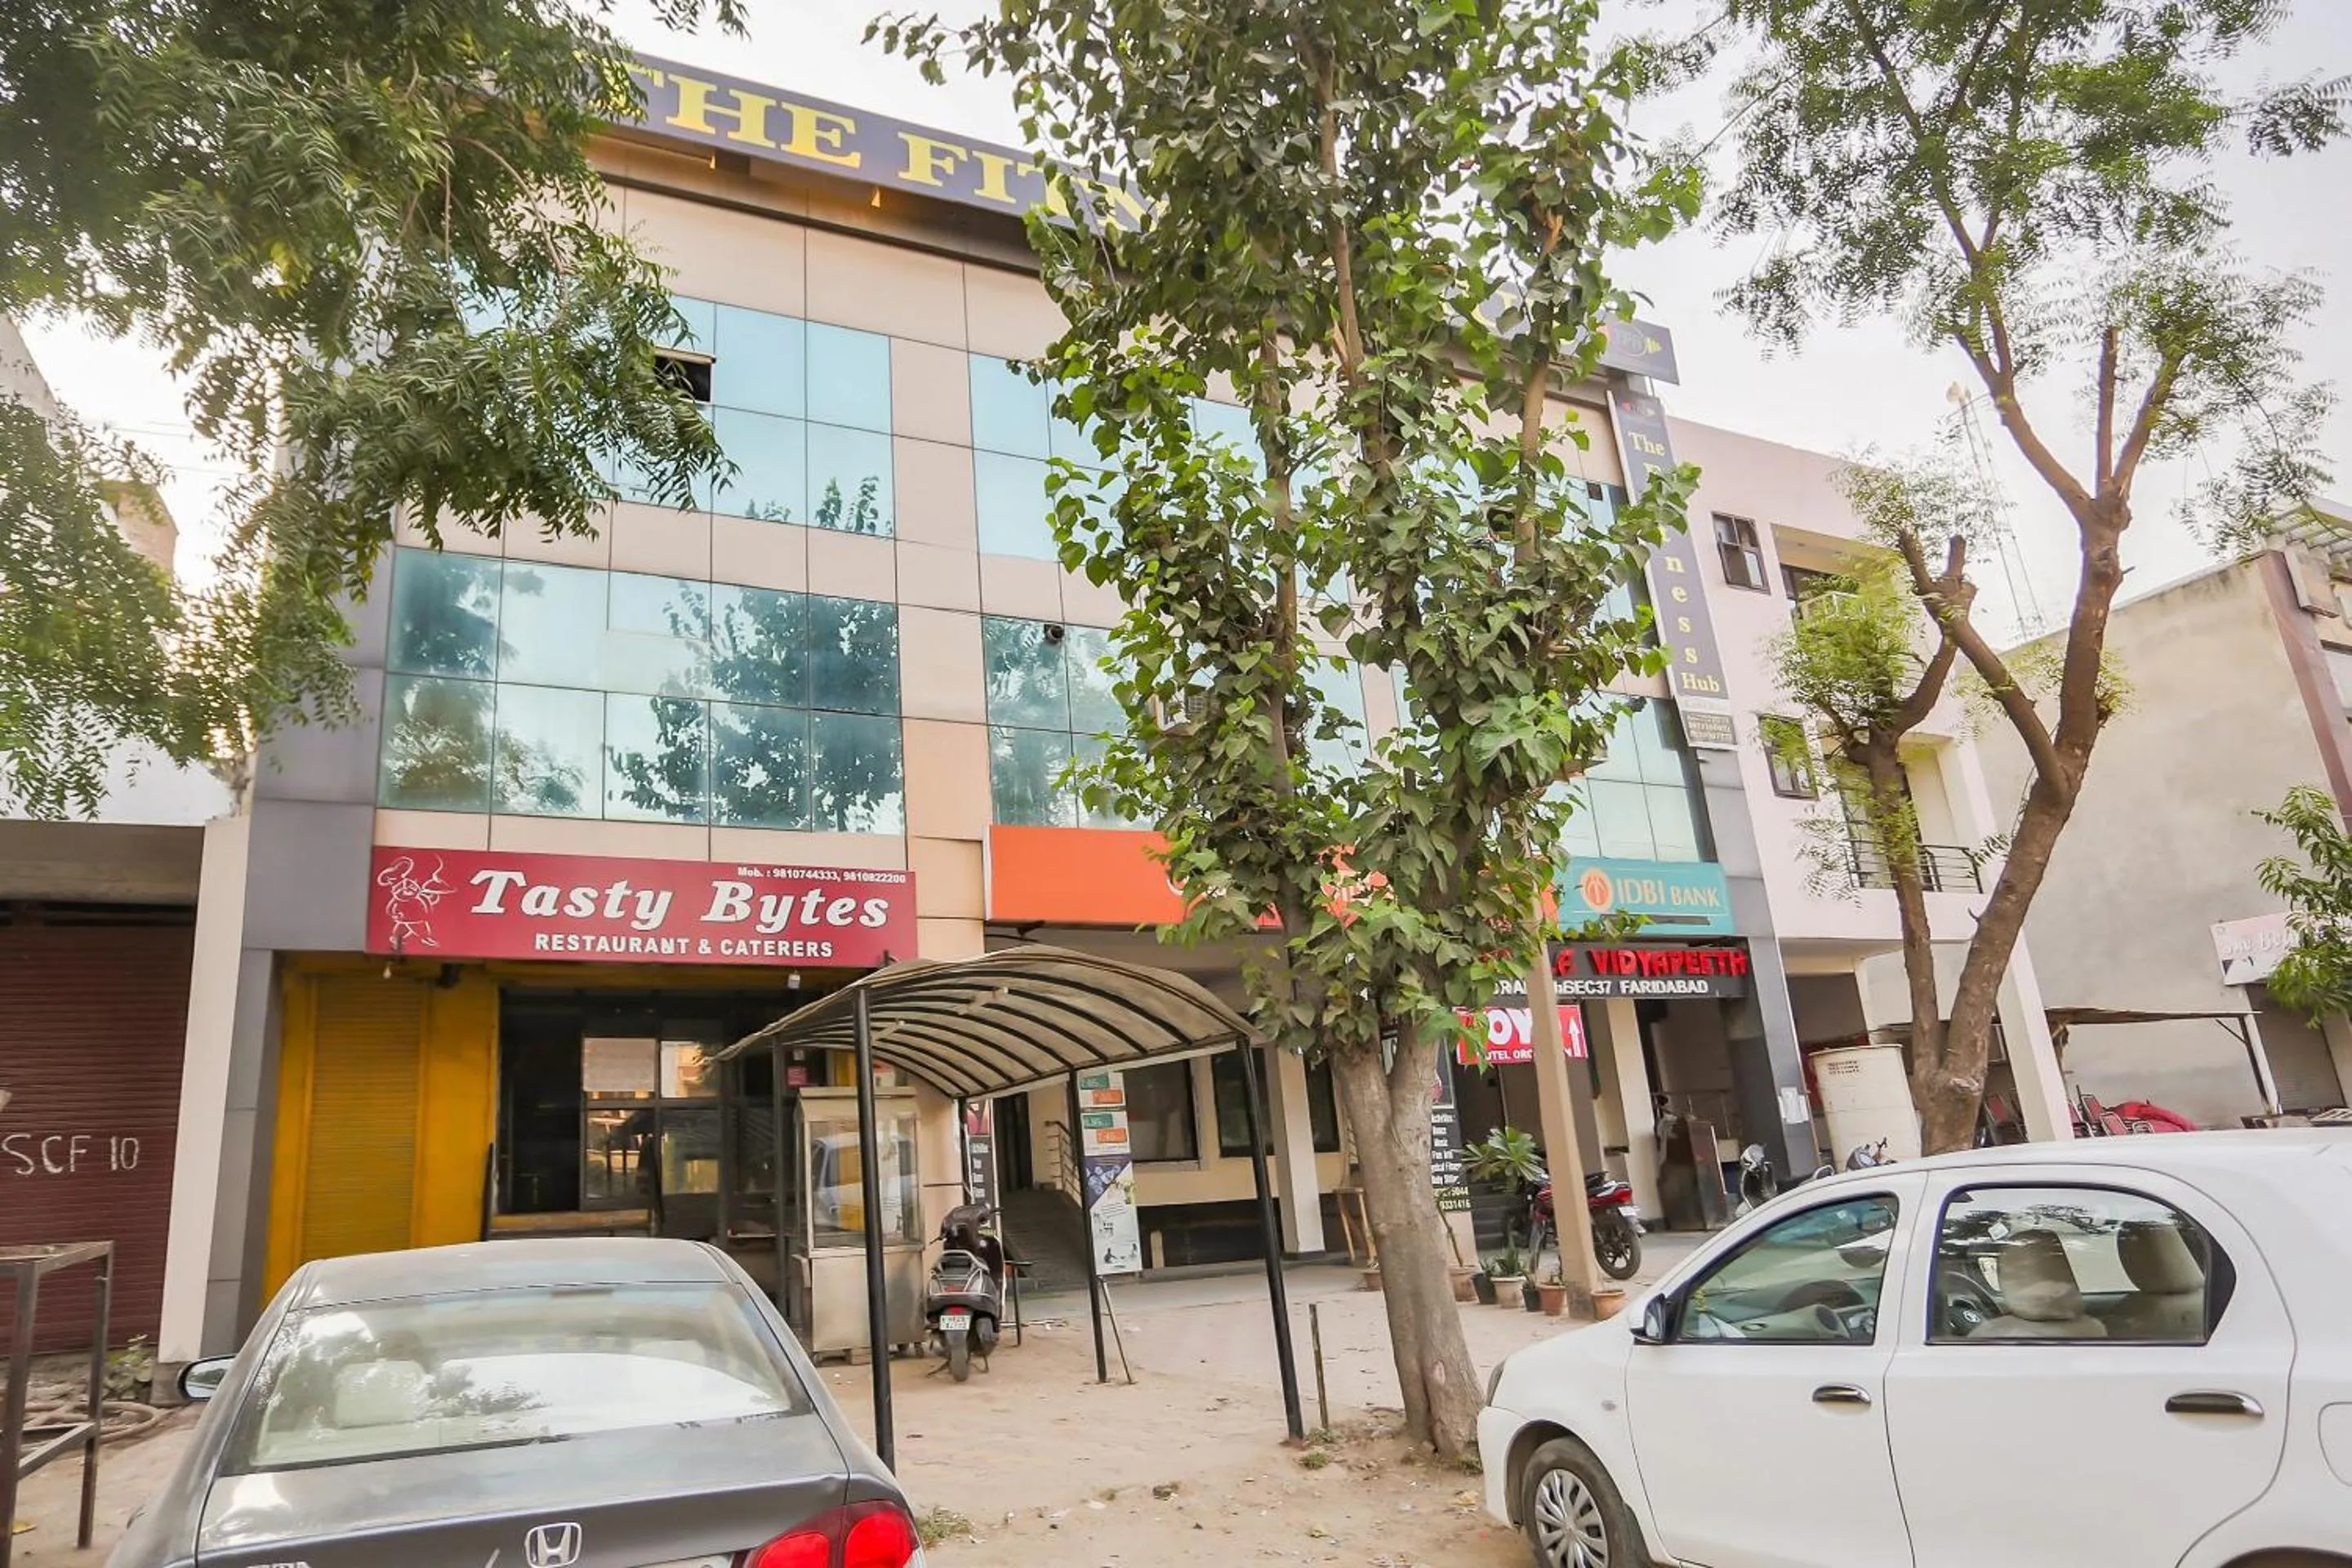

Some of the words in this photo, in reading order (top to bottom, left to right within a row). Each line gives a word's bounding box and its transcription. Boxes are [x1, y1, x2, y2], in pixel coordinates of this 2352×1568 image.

[1628, 431, 1665, 457] The
[1681, 672, 1720, 693] Hub
[470, 870, 673, 931] Tasty
[701, 880, 889, 933] Bytes
[1616, 878, 1665, 904] IDBI
[1670, 884, 1720, 907] BANK
[535, 933, 689, 955] RESTAURANT
[697, 938, 712, 954] &
[720, 939, 833, 957] CATERERS
[1589, 947, 1748, 977] VIDYAPEETH
[1619, 980, 1708, 995] FARIDABAD
[1487, 1008, 1534, 1045] OY
[2, 1134, 91, 1175] SCF
[110, 1136, 139, 1170] 10
